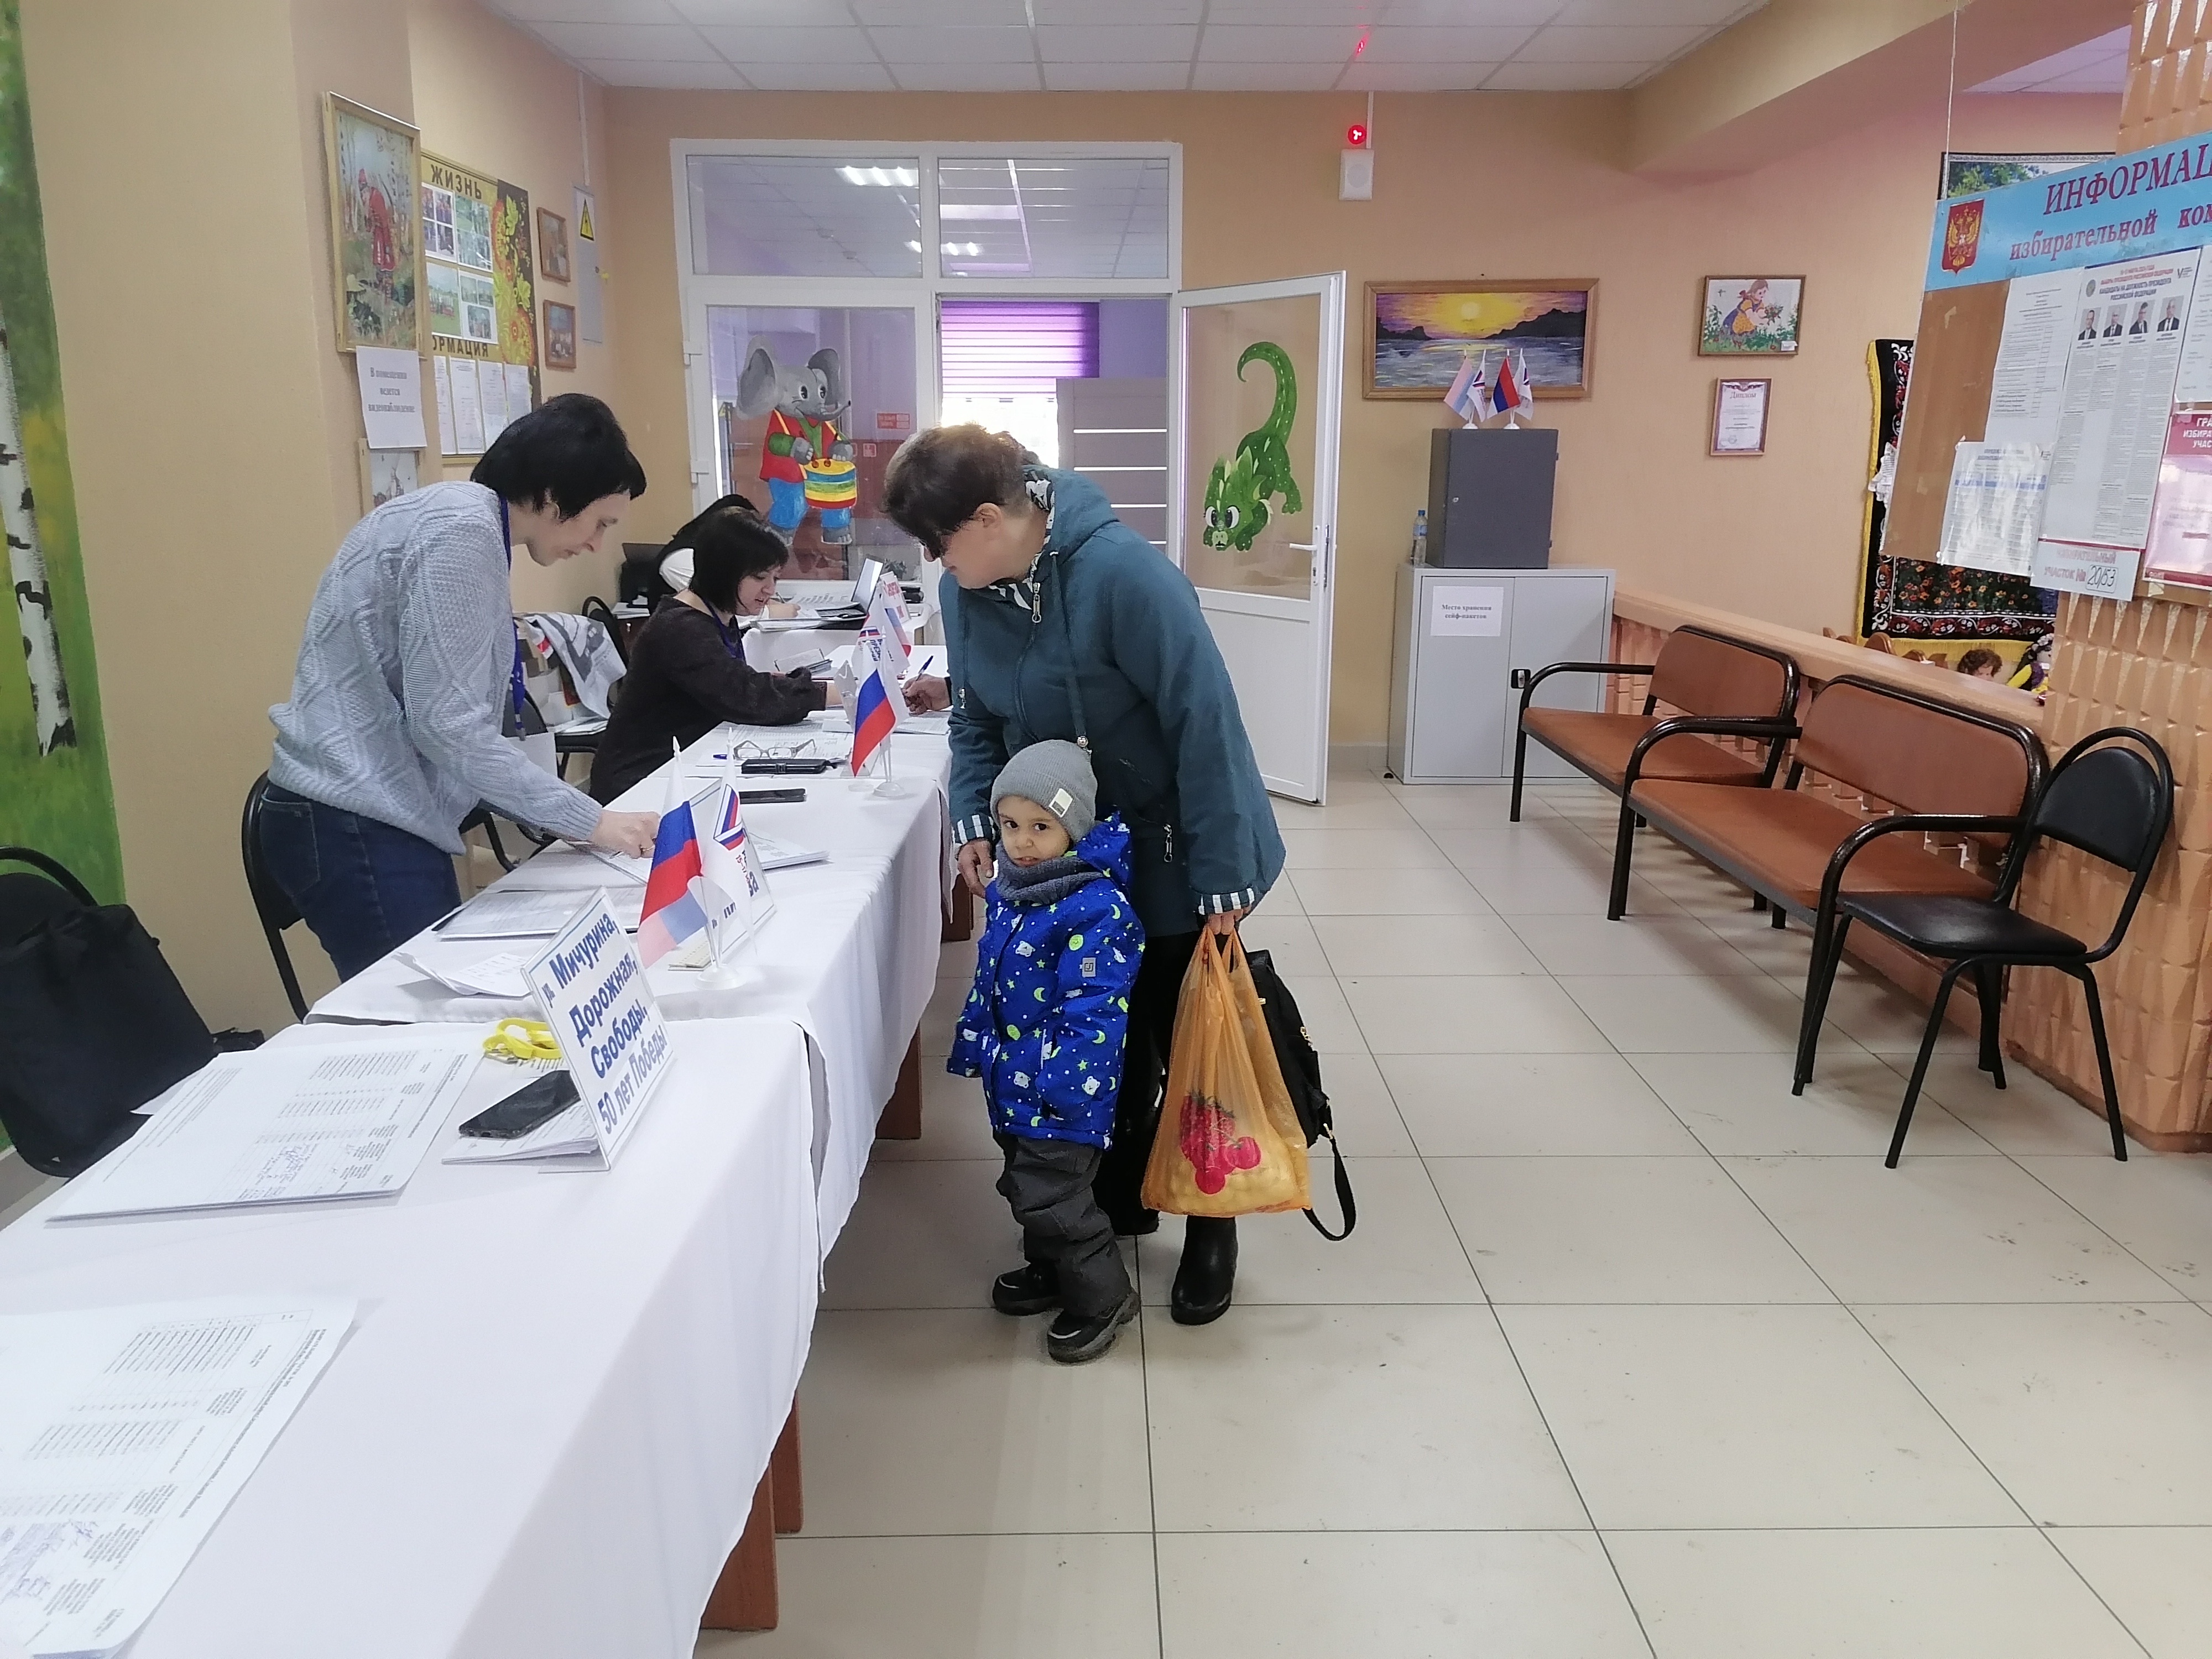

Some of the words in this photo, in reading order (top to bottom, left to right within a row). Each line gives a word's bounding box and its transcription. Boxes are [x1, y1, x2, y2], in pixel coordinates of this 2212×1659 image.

[430, 164, 482, 200] ЖИЗНЬ
[2009, 208, 2158, 262] избирательной
[370, 367, 375, 377] В
[2087, 565, 2116, 589] 20/53
[549, 912, 620, 989] Мичурина,
[569, 952, 638, 1048] Дорожная,
[591, 999, 650, 1078] Свободы,
[597, 1091, 617, 1135] 50
[614, 1072, 632, 1116] лет
[628, 1024, 667, 1089] Победы
